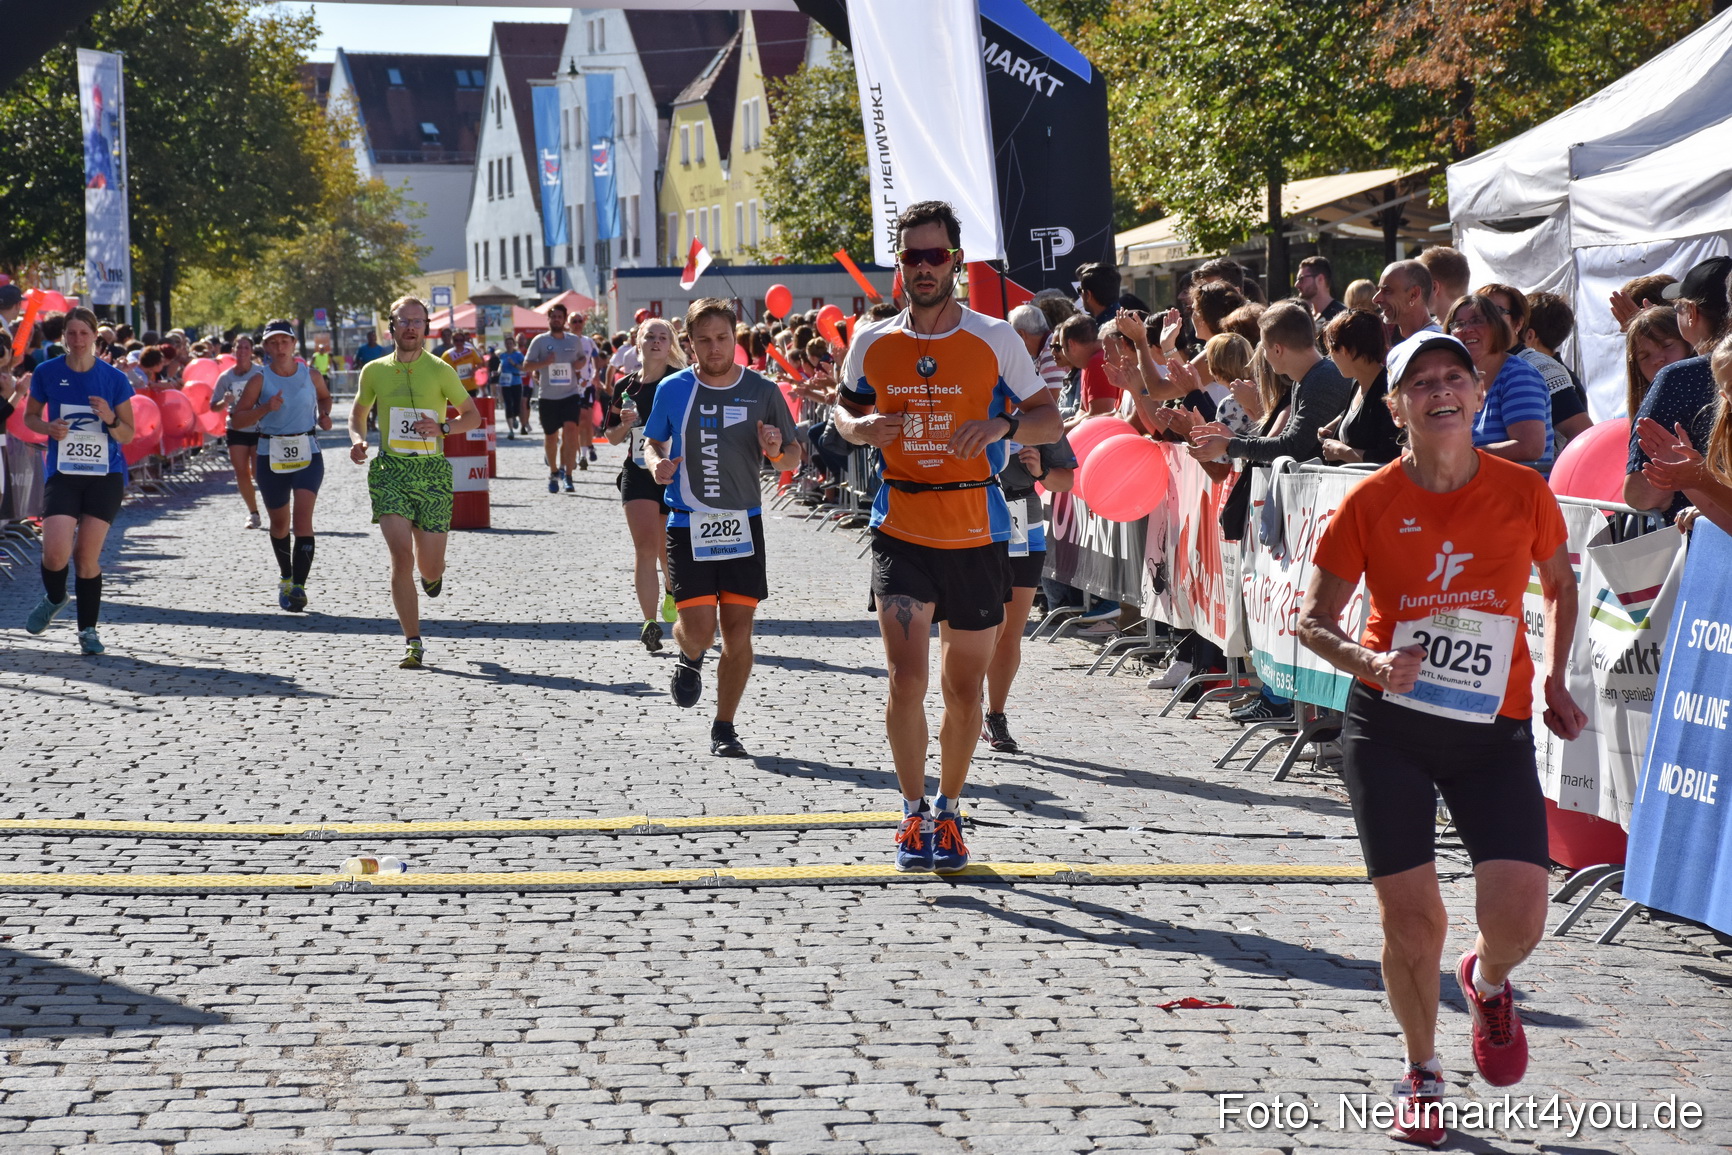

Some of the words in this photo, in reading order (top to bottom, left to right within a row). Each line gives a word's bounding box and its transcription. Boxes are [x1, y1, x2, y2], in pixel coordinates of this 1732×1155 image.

[886, 384, 962, 395] SportScheck
[928, 414, 953, 422] Stadt
[928, 422, 950, 431] Lauf
[66, 443, 102, 458] 2352
[283, 446, 299, 458] 39
[700, 404, 720, 498] HIMATEC
[700, 519, 743, 538] 2282
[1399, 525, 1422, 533] erima
[710, 547, 738, 555] Markus
[1399, 589, 1495, 611] funrunners
[1432, 614, 1483, 633] BOCK
[1412, 630, 1494, 677] 3025
[1436, 674, 1471, 686] Neumarkt
[1621, 687, 1657, 704] genieß
[1673, 690, 1730, 730] ONLINE
[1657, 762, 1719, 805] MOBILE
